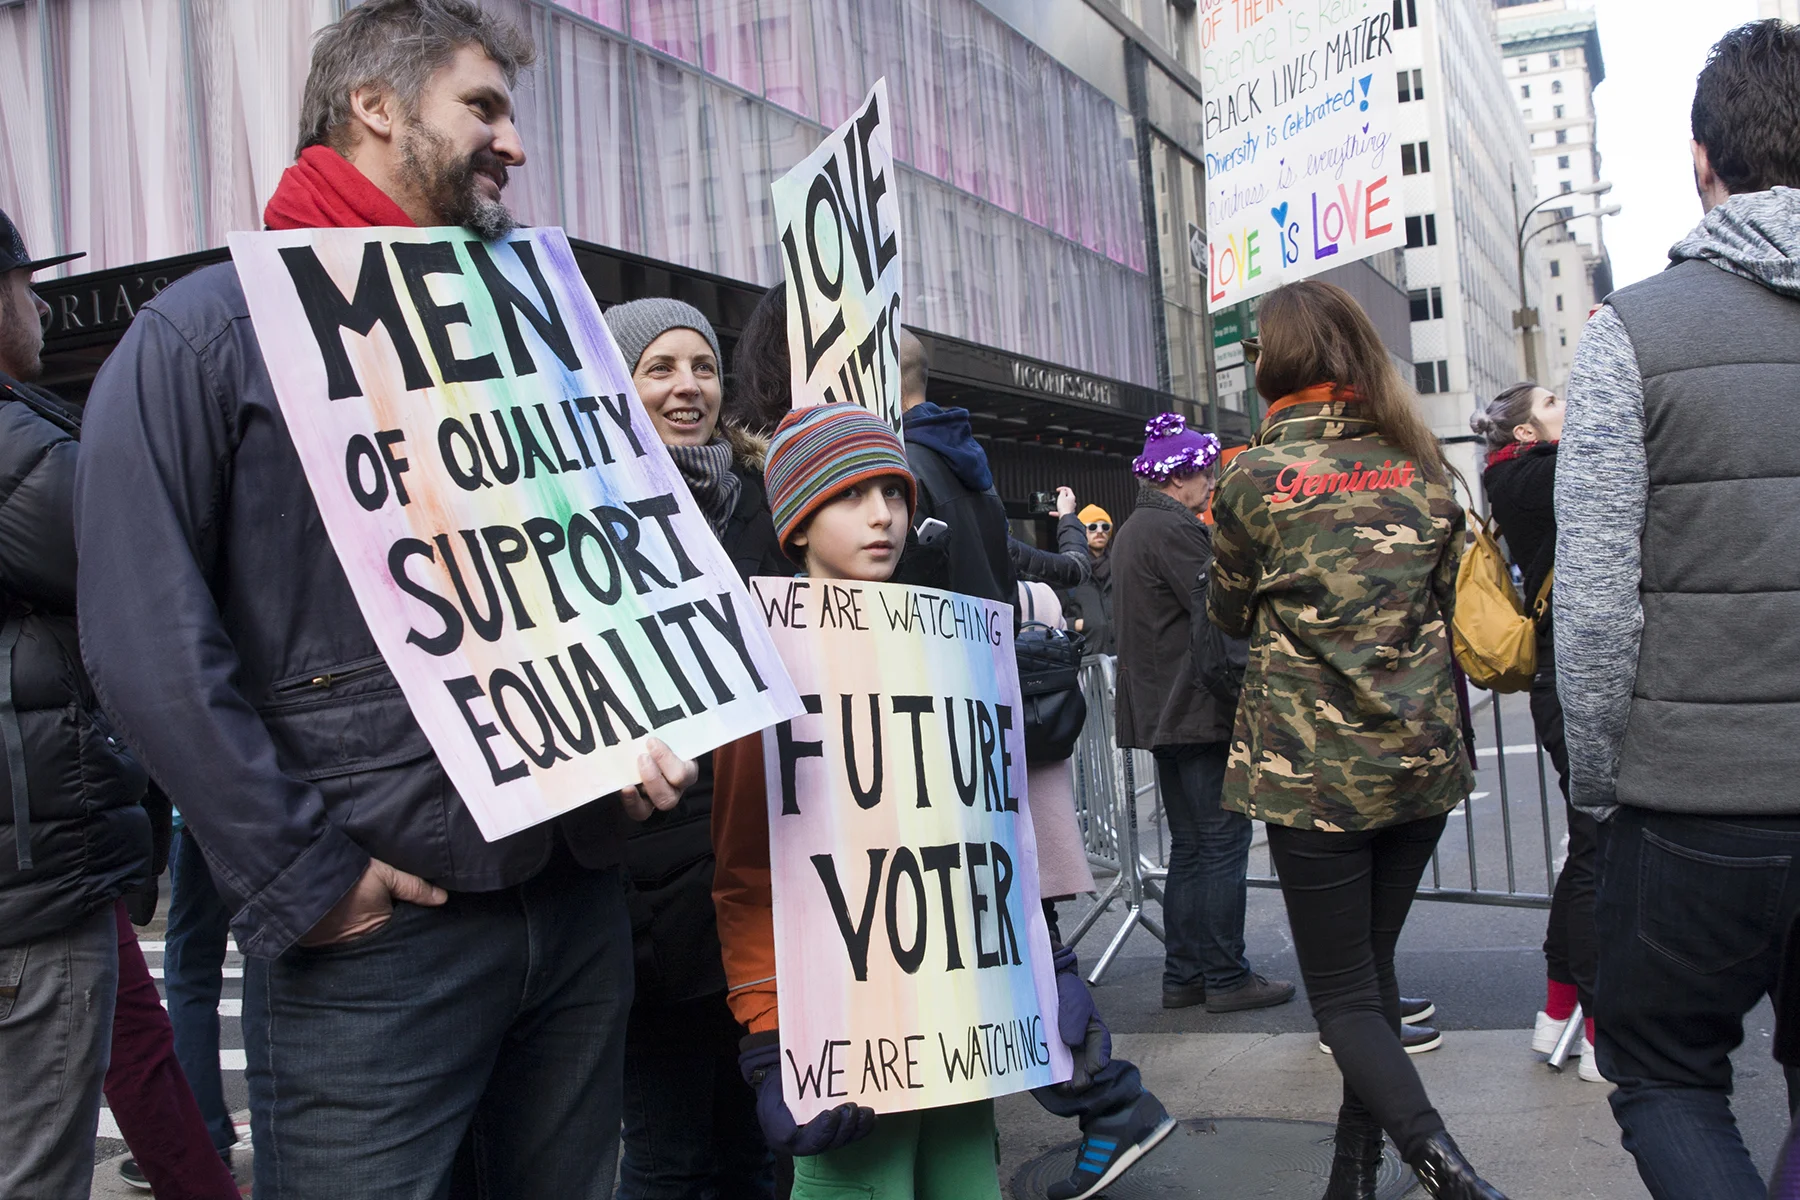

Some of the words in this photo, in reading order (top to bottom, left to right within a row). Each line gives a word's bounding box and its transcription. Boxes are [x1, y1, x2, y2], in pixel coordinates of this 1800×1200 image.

[1201, 7, 1223, 49] OF
[1203, 27, 1277, 94] Science
[1318, 0, 1367, 33] Rea
[1205, 78, 1262, 140] BLACK
[1273, 50, 1318, 107] LIVES
[1325, 12, 1393, 81] MATTER
[1205, 132, 1260, 180] Diversity
[1266, 125, 1278, 149] is
[1277, 157, 1298, 190] is
[1303, 122, 1392, 180] everything
[781, 92, 898, 385] LOVE
[1209, 227, 1262, 303] LOVE
[1312, 175, 1393, 260] LOVE
[277, 240, 582, 400] MEN
[346, 428, 411, 512] OF
[437, 393, 648, 493] QUALITY
[1271, 459, 1417, 503] Feminist
[387, 493, 704, 657] SUPPORT
[753, 581, 810, 630] WE
[820, 585, 870, 631] ARE
[879, 591, 1002, 646] WATCHING
[442, 592, 769, 787] EQUALITY
[776, 694, 1020, 816] FUTURE
[810, 841, 1022, 982] VOTER
[786, 1040, 852, 1101] WE
[860, 1034, 925, 1095] ARE
[939, 1014, 1051, 1084] WATCHING
